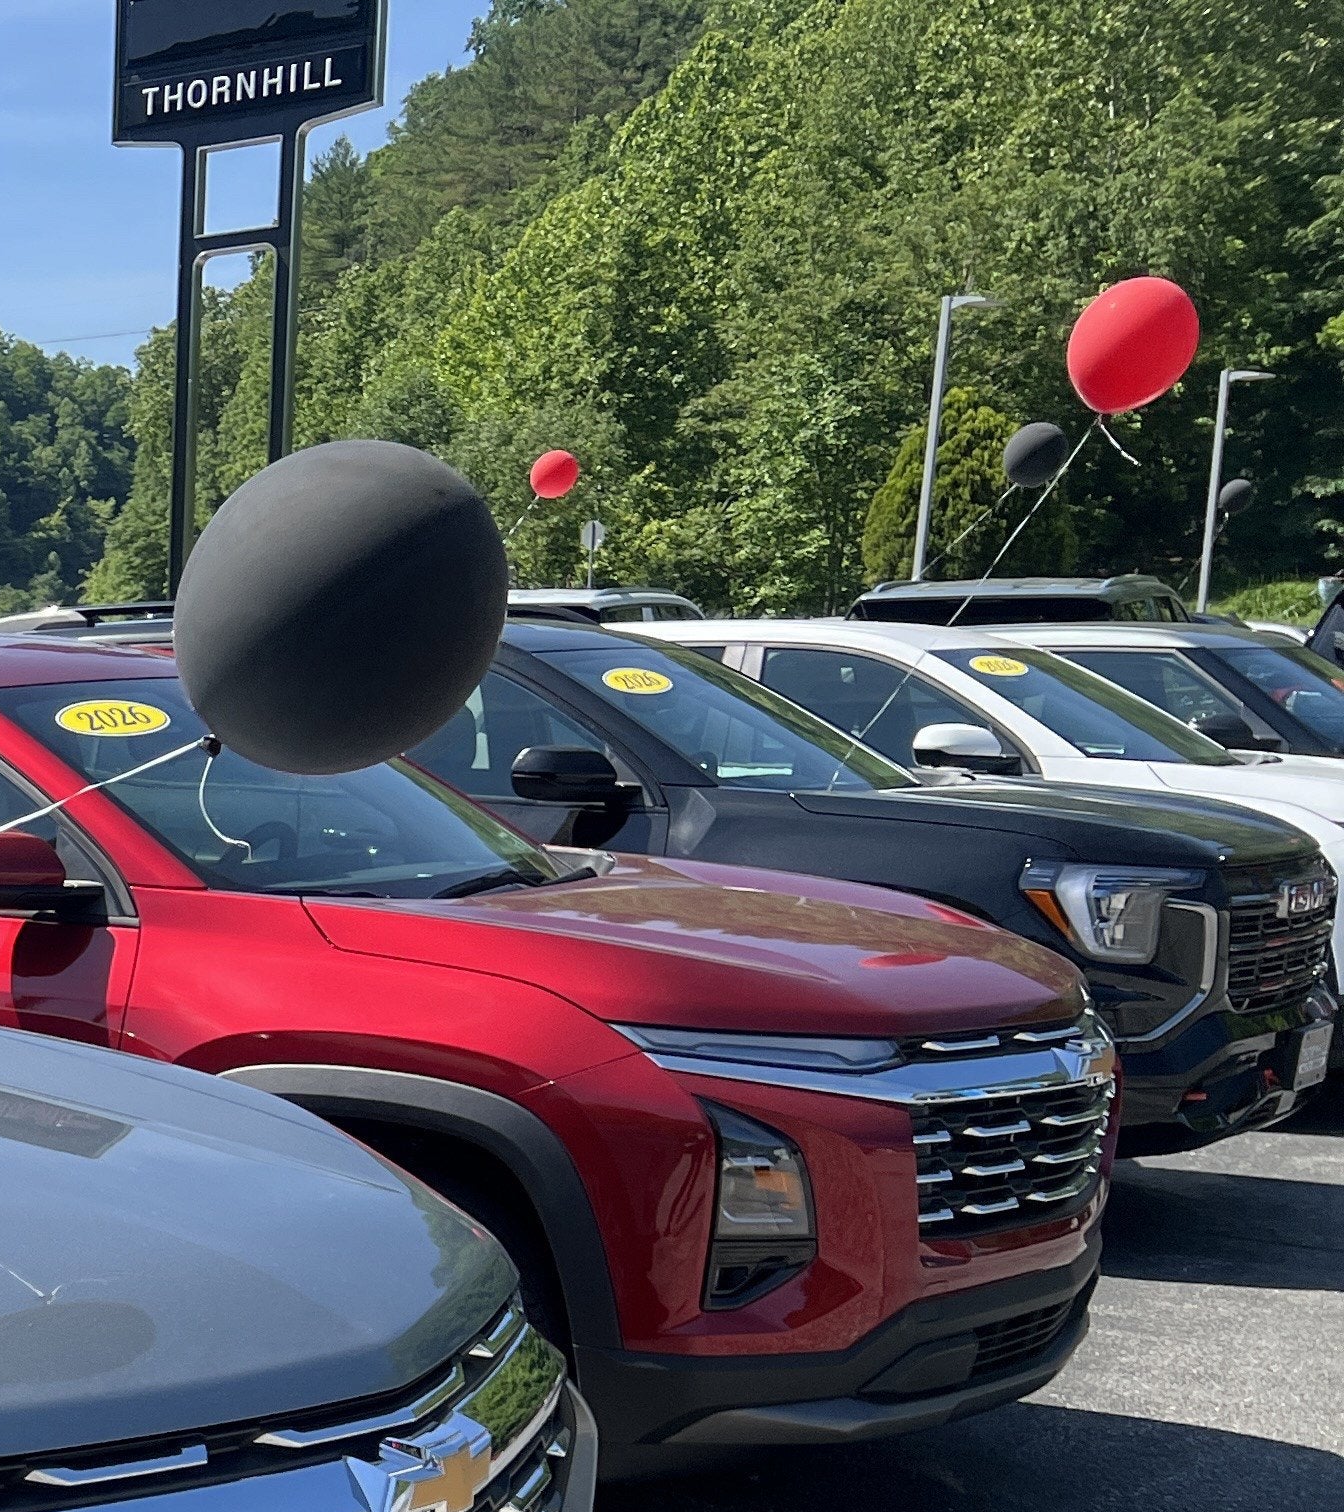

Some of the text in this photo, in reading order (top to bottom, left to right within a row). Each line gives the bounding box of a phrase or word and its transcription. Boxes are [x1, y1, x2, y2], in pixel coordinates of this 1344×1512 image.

[141, 57, 343, 116] THORNHILL
[614, 671, 661, 690] 2026
[76, 705, 151, 731] 2026
